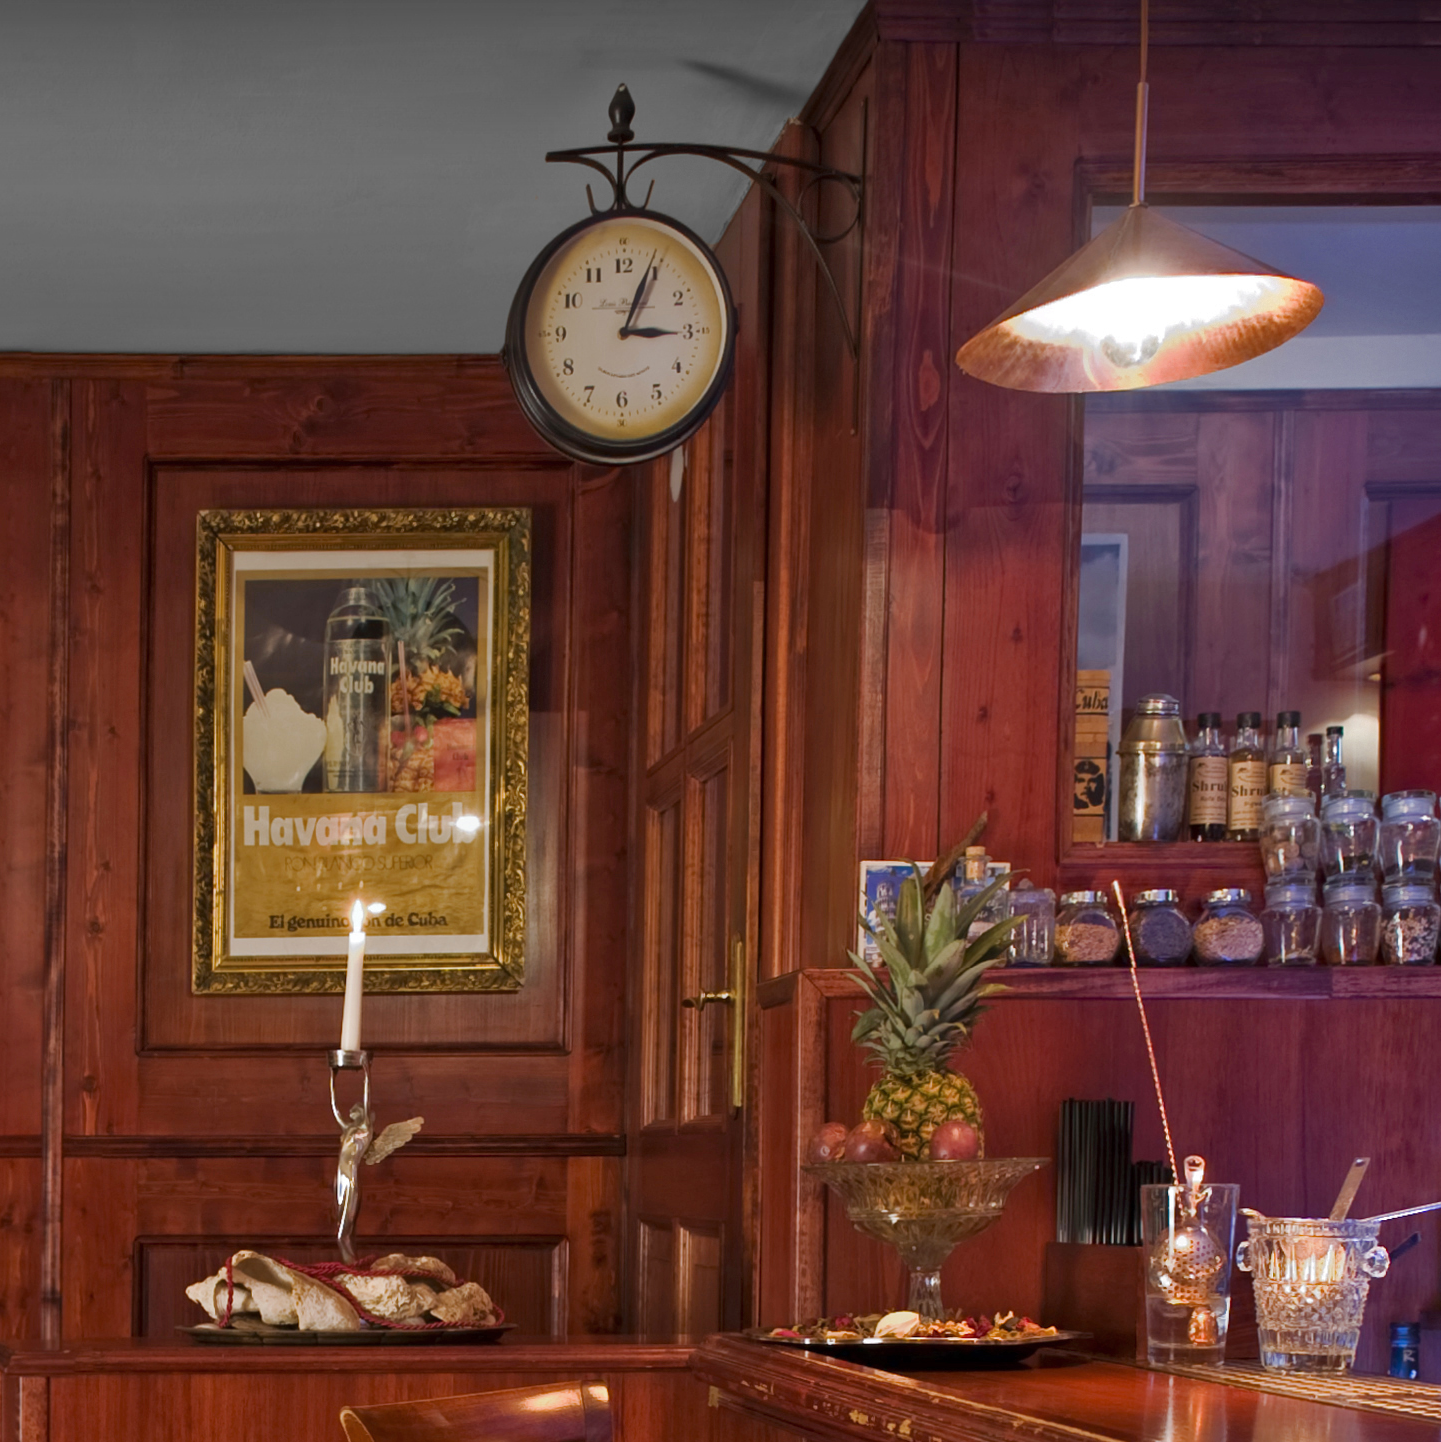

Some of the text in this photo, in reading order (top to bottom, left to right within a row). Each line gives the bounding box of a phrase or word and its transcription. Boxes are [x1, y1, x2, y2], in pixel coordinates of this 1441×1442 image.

[615, 258, 633, 274] 12
[652, 266, 658, 281] 1
[585, 267, 602, 283] 11
[564, 293, 584, 309] 10
[673, 290, 684, 306] 2
[555, 326, 567, 343] 9
[683, 323, 694, 340] 3
[563, 358, 574, 376] 8
[671, 357, 681, 374] 4
[584, 385, 595, 403] 7
[616, 391, 628, 408] 6
[651, 384, 662, 401] 5
[330, 657, 385, 675] Havana
[339, 676, 374, 694] Club
[1231, 785, 1265, 797] Shru
[243, 802, 478, 846] Havana Club
[285, 856, 316, 872] RON
[377, 854, 433, 871] SUPERIOR
[269, 915, 285, 929] El
[385, 913, 404, 928] de
[407, 912, 448, 927] Cuba
